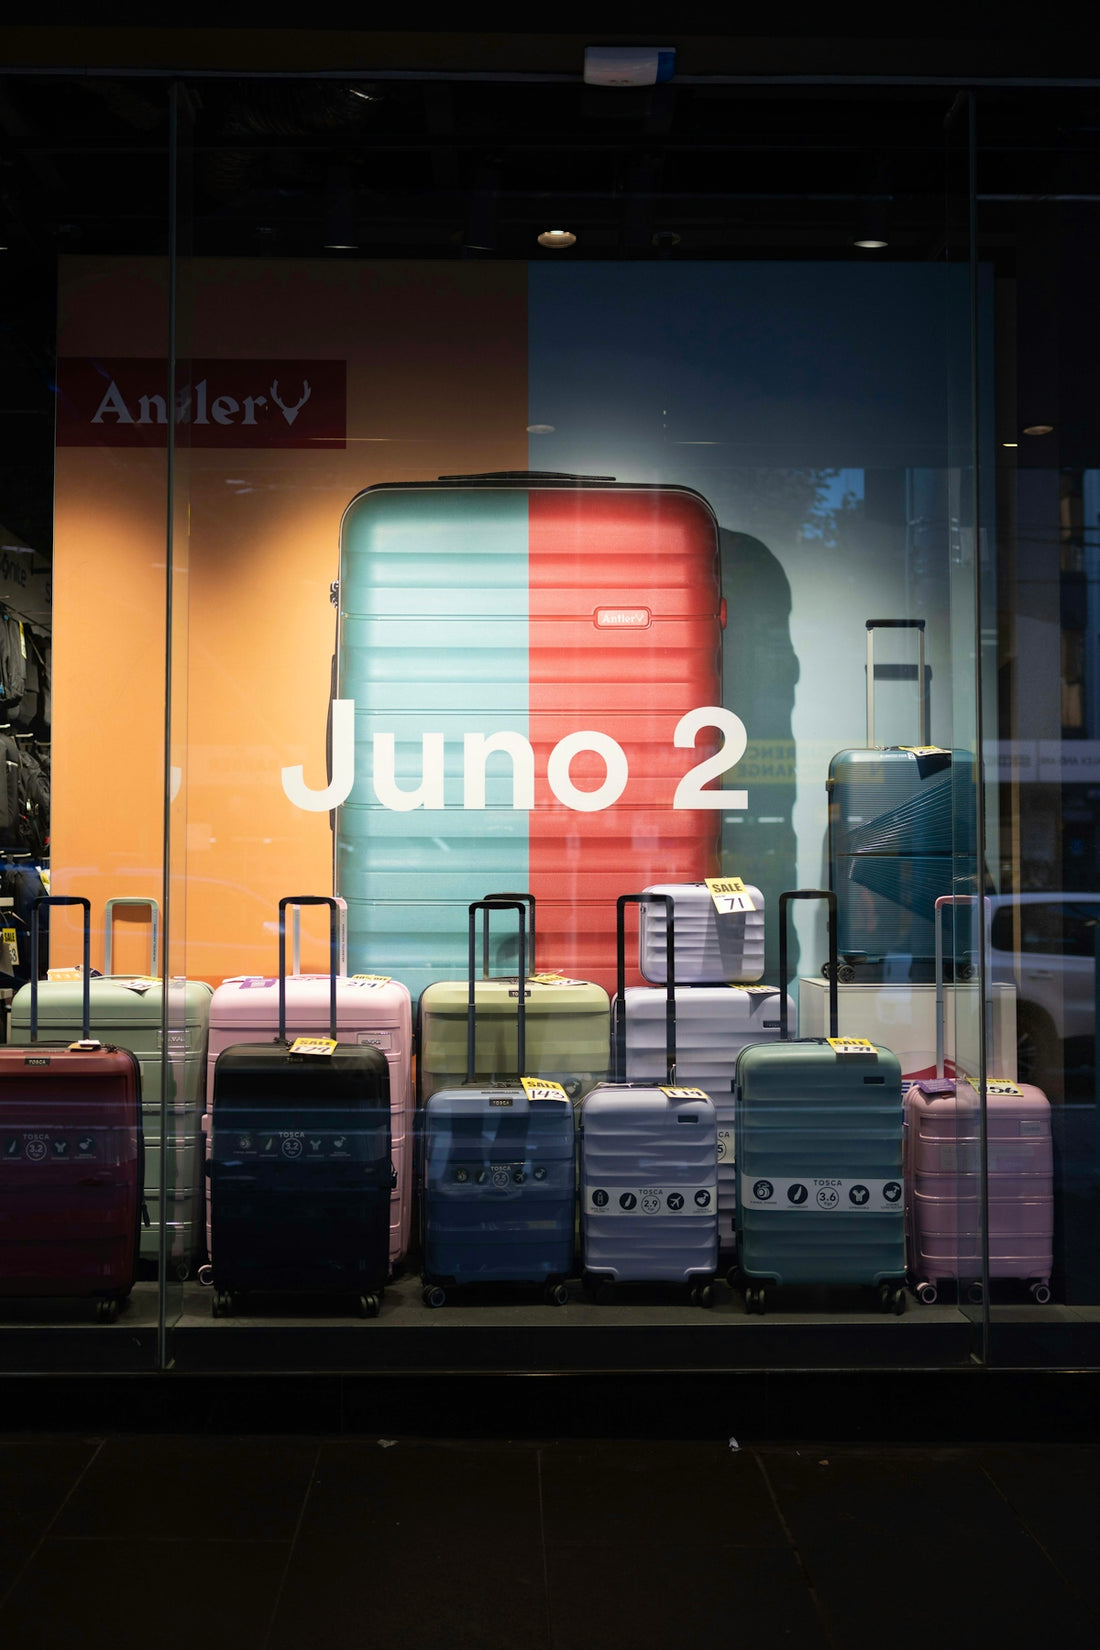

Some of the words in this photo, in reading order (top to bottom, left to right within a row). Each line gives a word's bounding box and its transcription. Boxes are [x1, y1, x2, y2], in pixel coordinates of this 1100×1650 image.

[281, 699, 629, 812] Juno
[673, 706, 748, 810] 2
[711, 883, 743, 893] SALE
[723, 897, 744, 910] 71
[527, 1081, 559, 1089] SALE
[532, 1090, 565, 1099] 143
[29, 1144, 43, 1153] 3.2
[285, 1142, 299, 1150] 3.2
[819, 1192, 836, 1201] 3.6
[644, 1199, 658, 1208] 2.9
